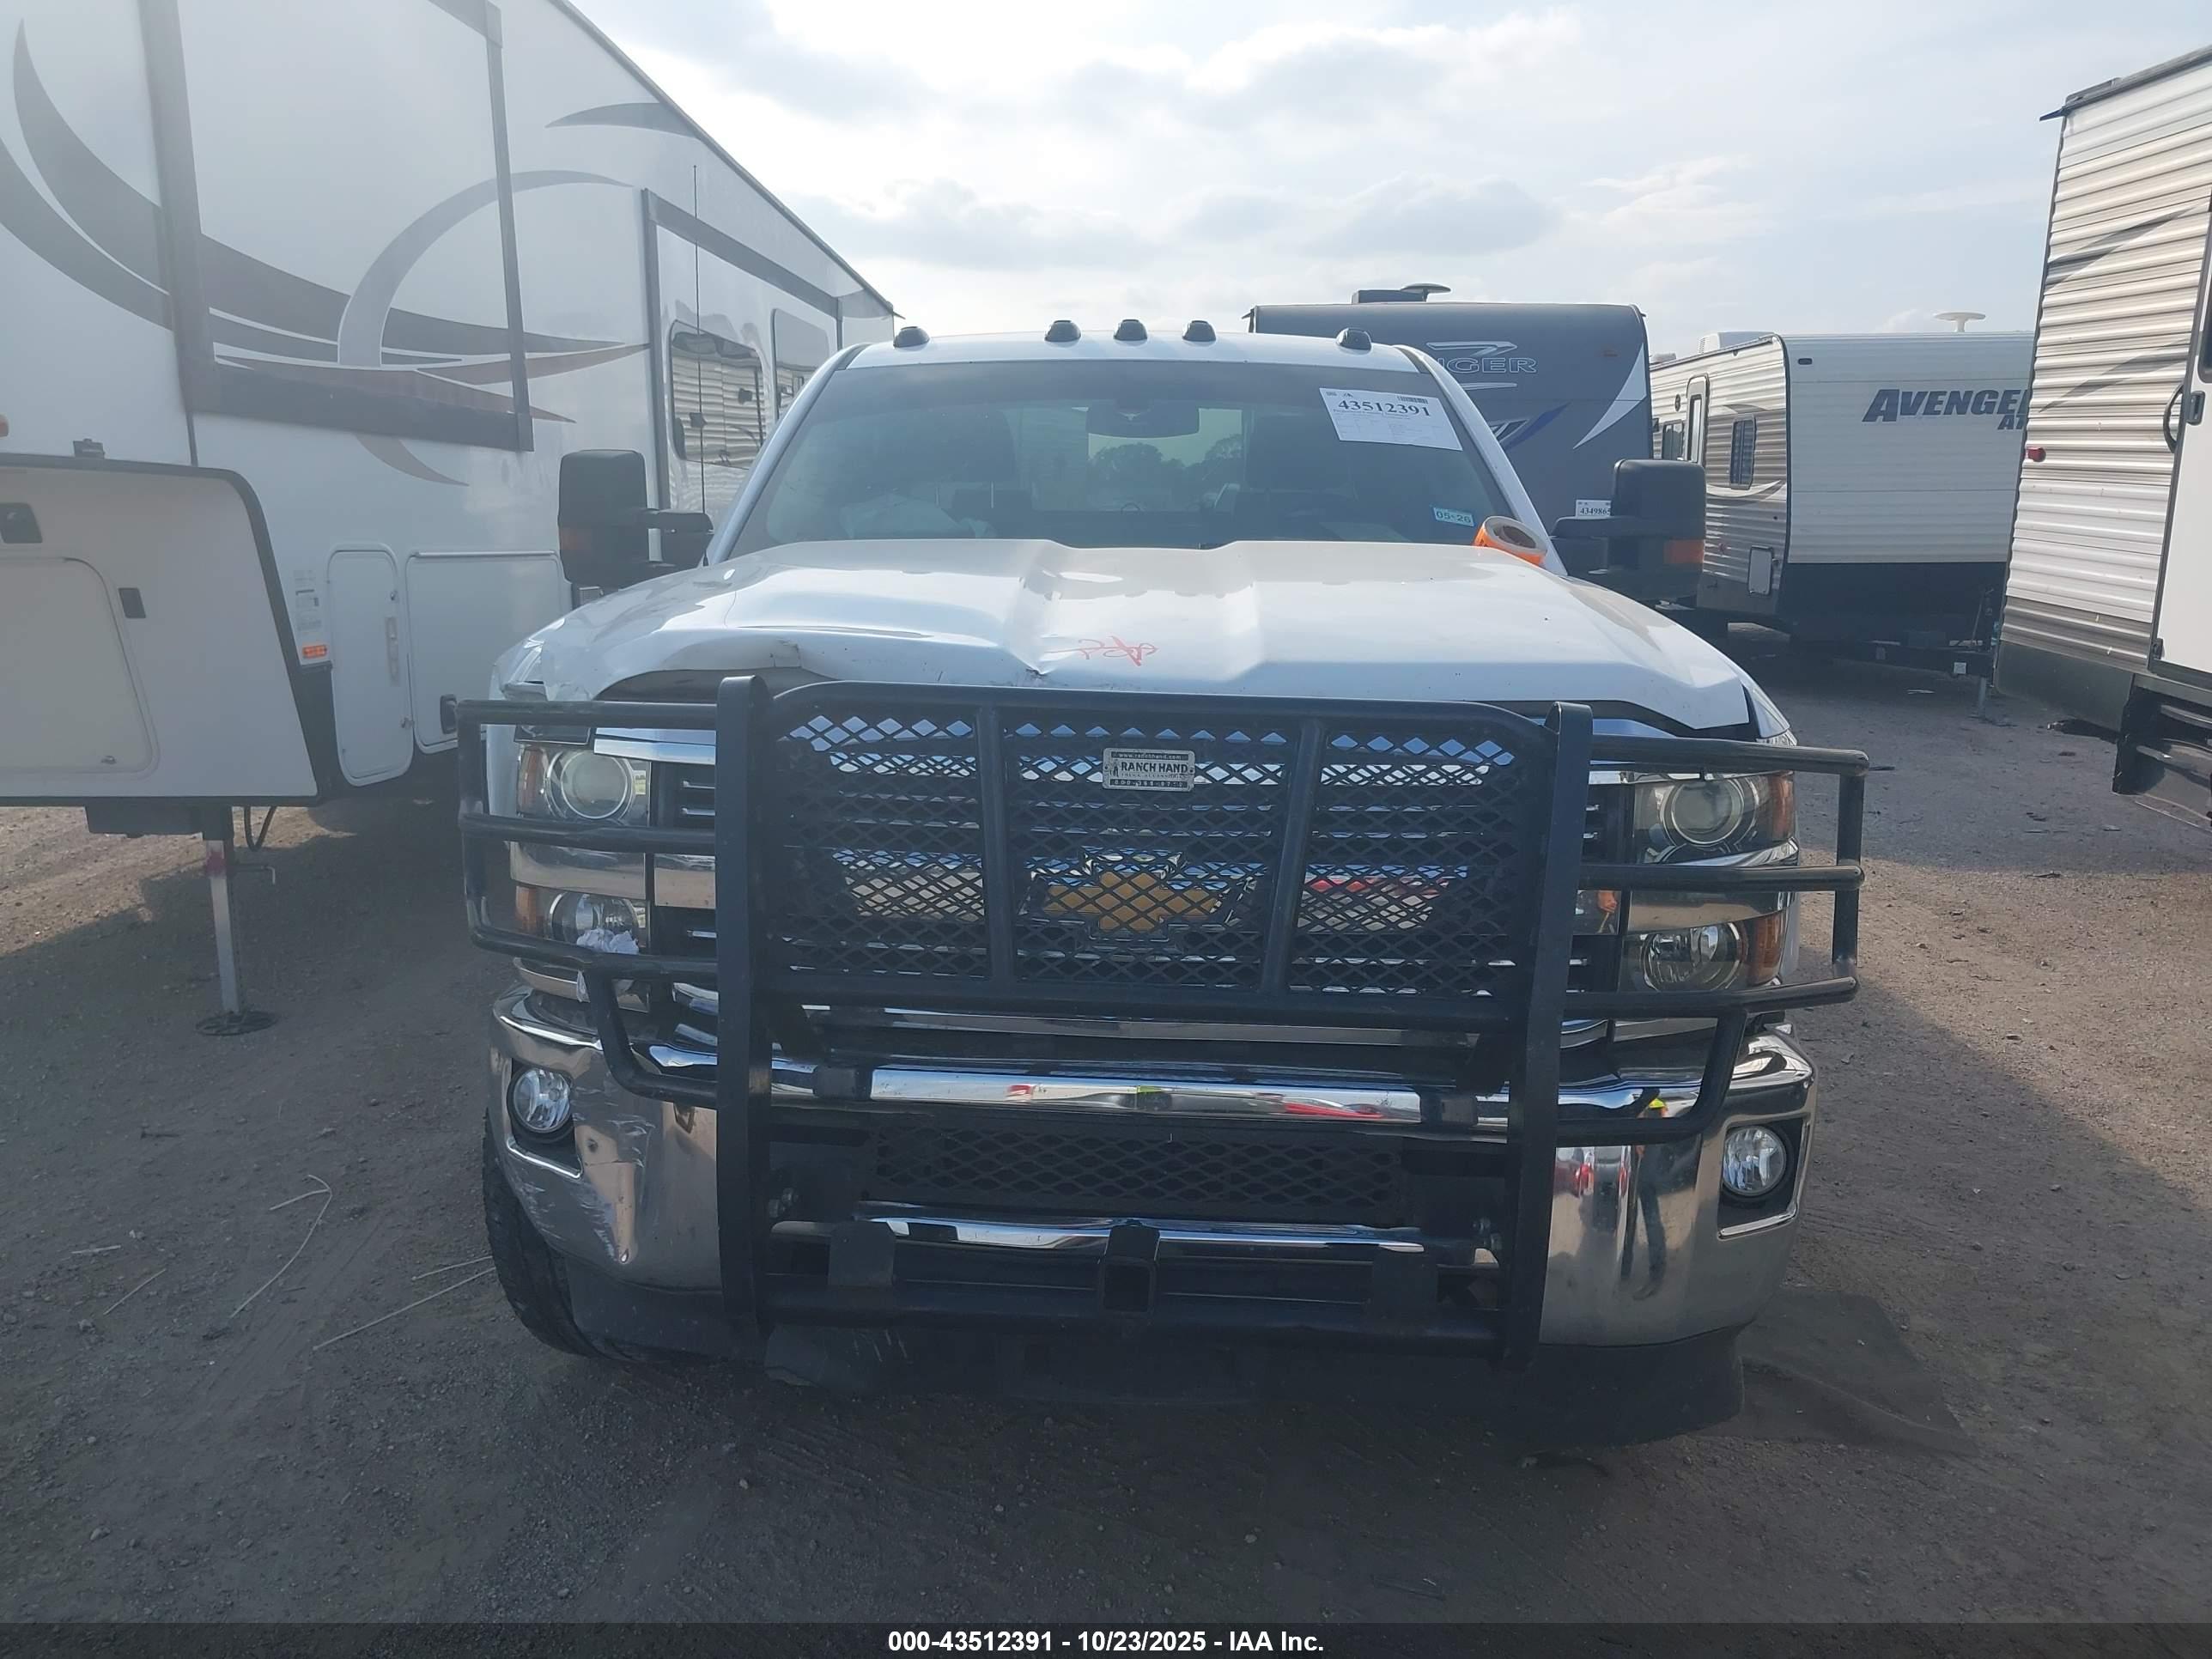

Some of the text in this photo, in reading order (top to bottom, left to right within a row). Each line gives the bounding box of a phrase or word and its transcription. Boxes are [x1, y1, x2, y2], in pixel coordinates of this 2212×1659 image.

[1338, 399, 1431, 416] 43512391
[1121, 762, 1188, 773] RANCH HAND
